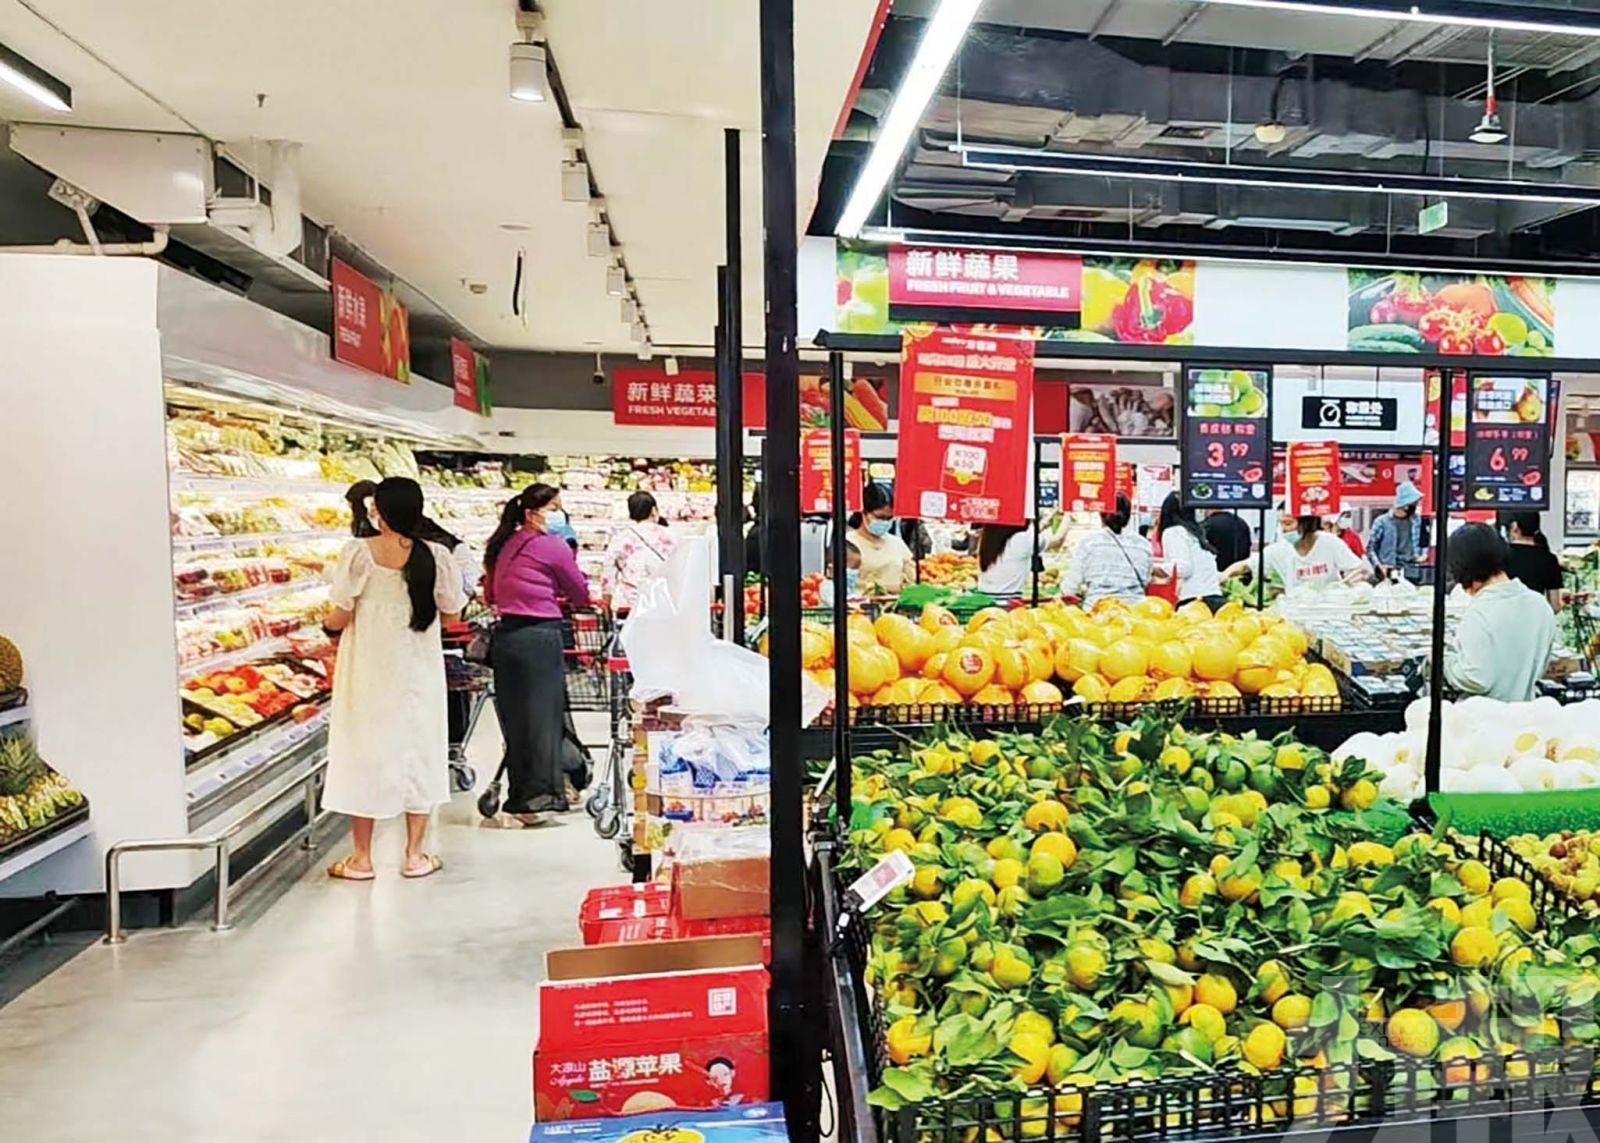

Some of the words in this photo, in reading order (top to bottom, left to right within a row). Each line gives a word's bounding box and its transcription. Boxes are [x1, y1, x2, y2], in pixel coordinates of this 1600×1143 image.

[905, 250, 1019, 280] 新鲜蔬果
[907, 280, 947, 293] FRESH
[951, 281, 984, 295] FRUIT
[987, 283, 998, 296] &
[999, 283, 1069, 298] VEGETABLE
[336, 284, 367, 328] 新鲜水果
[627, 382, 716, 404] 新鲜蔬菜
[628, 405, 664, 415] FRESH
[588, 1053, 682, 1082] 盐源苹果
